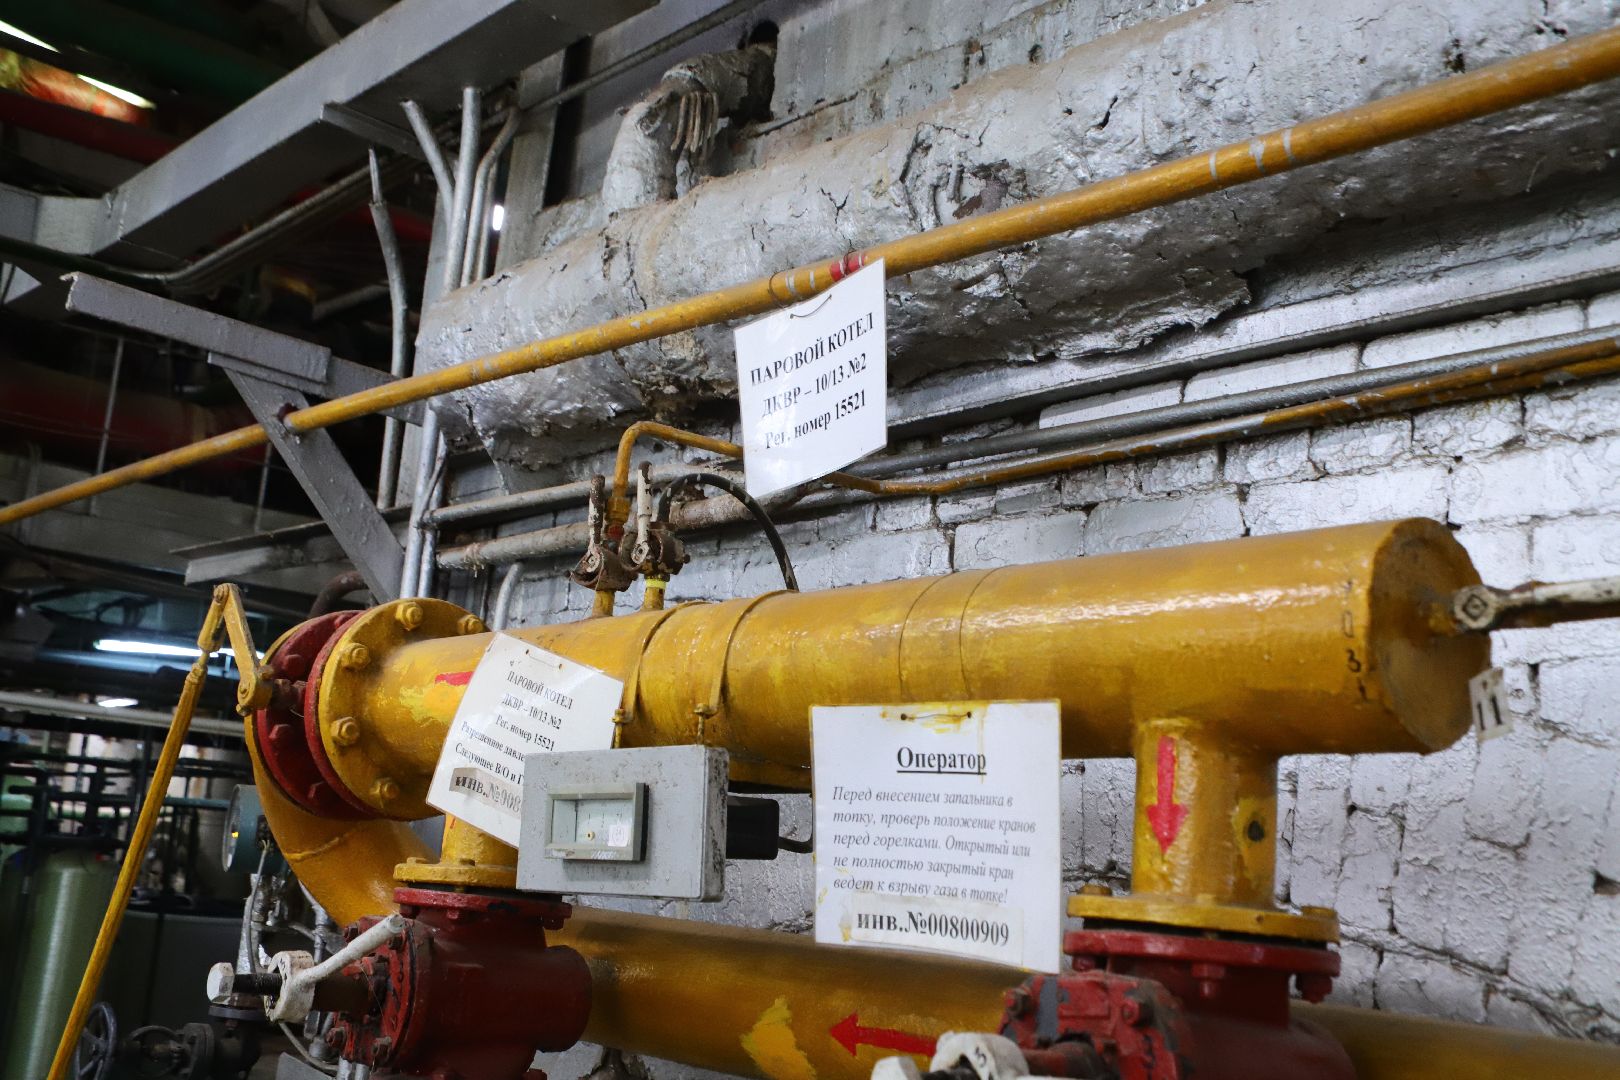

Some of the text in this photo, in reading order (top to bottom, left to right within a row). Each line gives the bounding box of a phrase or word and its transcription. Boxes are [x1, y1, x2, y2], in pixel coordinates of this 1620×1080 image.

[750, 312, 874, 386] ПАРОВОЙ КОТЕЛ
[761, 386, 801, 418] ДКВР
[815, 365, 844, 395] 10/13
[847, 353, 867, 379] №2
[765, 389, 866, 449] Рег. номер 15521
[506, 670, 573, 710] ПАРОВОЙ КОТЕЛ
[501, 693, 524, 711] ДКВР
[529, 706, 548, 723] 10/13
[547, 714, 562, 730] №2
[495, 714, 555, 752] Рег. номер 15521
[455, 742, 494, 771] Следующее
[494, 759, 510, 779] В/О
[510, 772, 516, 781] и
[897, 746, 987, 774] Оператор
[832, 786, 1013, 807] Перед внесением запальника в
[833, 811, 1036, 836] топку, проверь положение кранов
[833, 831, 1030, 857] перед горелками. Открытый или
[833, 856, 1014, 880] не полностью закрытый кран
[833, 877, 1008, 904] ведет к взрыву газа в топке!
[857, 910, 1009, 946] инв.№00800909
